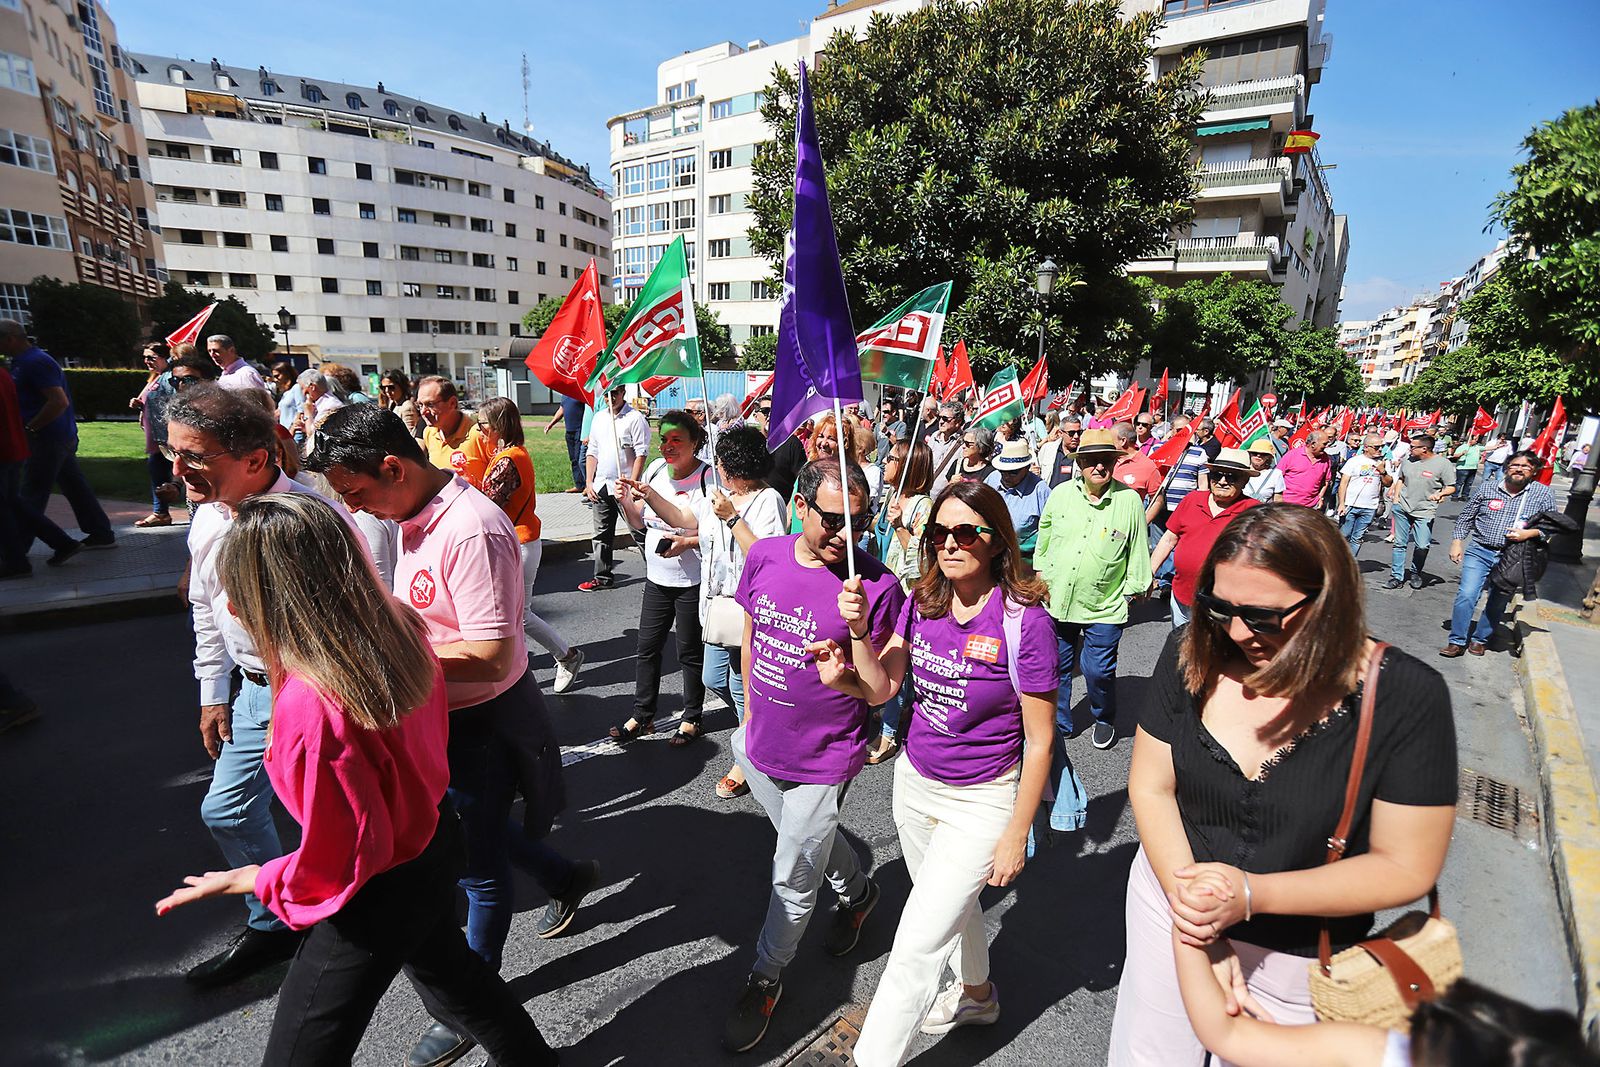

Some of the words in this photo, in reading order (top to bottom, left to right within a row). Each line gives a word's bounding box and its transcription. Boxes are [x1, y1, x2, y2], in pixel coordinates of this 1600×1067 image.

[759, 615, 771, 625] EN
[774, 620, 807, 638] LUCHA
[762, 647, 772, 659] LA
[775, 653, 807, 669] JUNTA
[925, 661, 960, 679] LUCHA
[917, 676, 965, 699] PRECARIO
[936, 694, 968, 712] JUNTA
